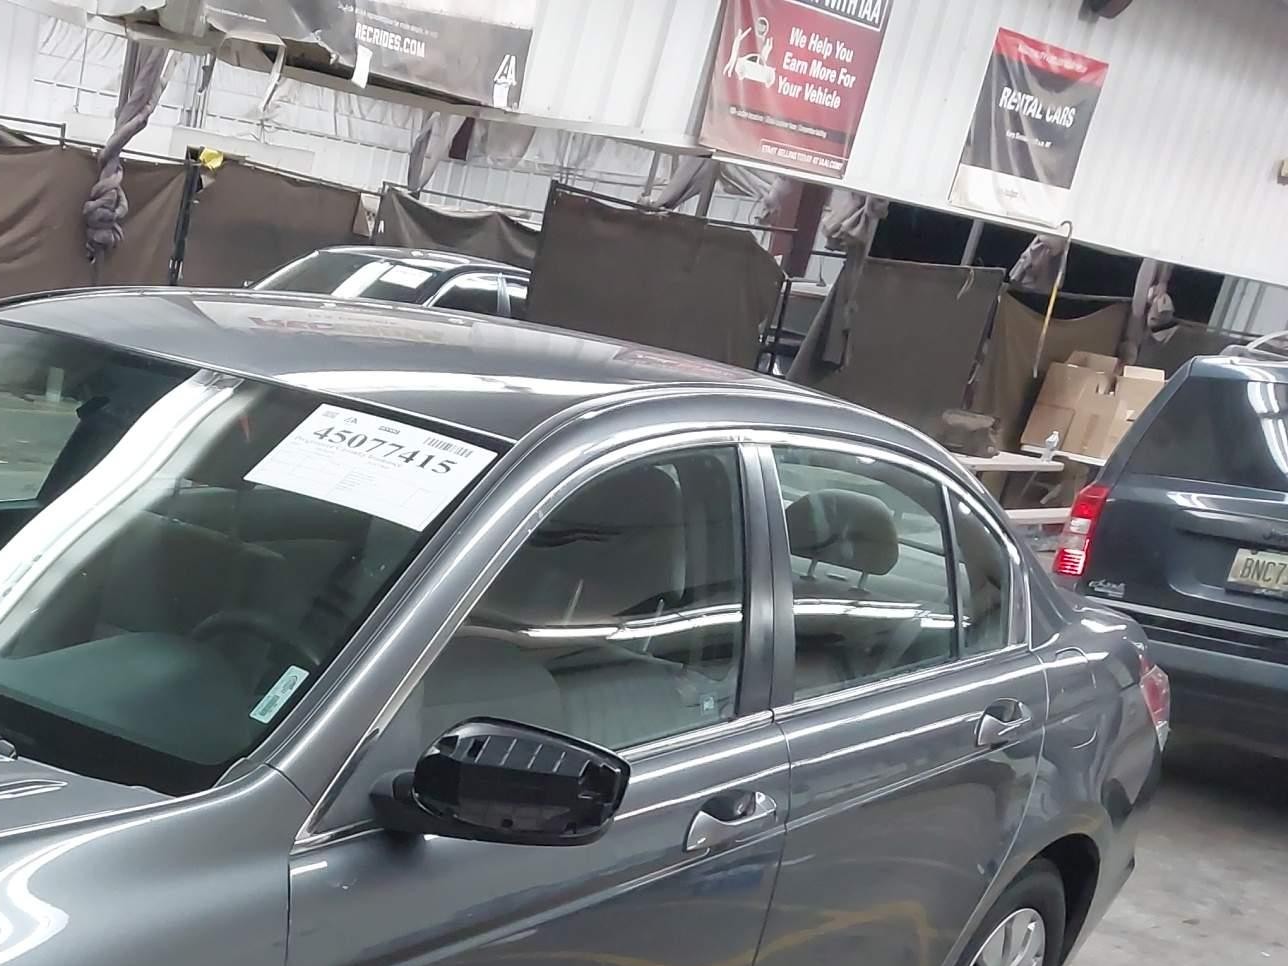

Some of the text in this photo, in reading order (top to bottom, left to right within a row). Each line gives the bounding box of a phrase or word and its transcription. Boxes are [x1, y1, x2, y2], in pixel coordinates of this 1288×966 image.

[789, 27, 853, 62] We Help You
[782, 52, 856, 88] Earn More For
[778, 75, 841, 109] Your Vehicle
[999, 87, 1076, 128] RENTAL CARS
[313, 426, 458, 474] 45077415
[1240, 557, 1288, 586] BNC7
